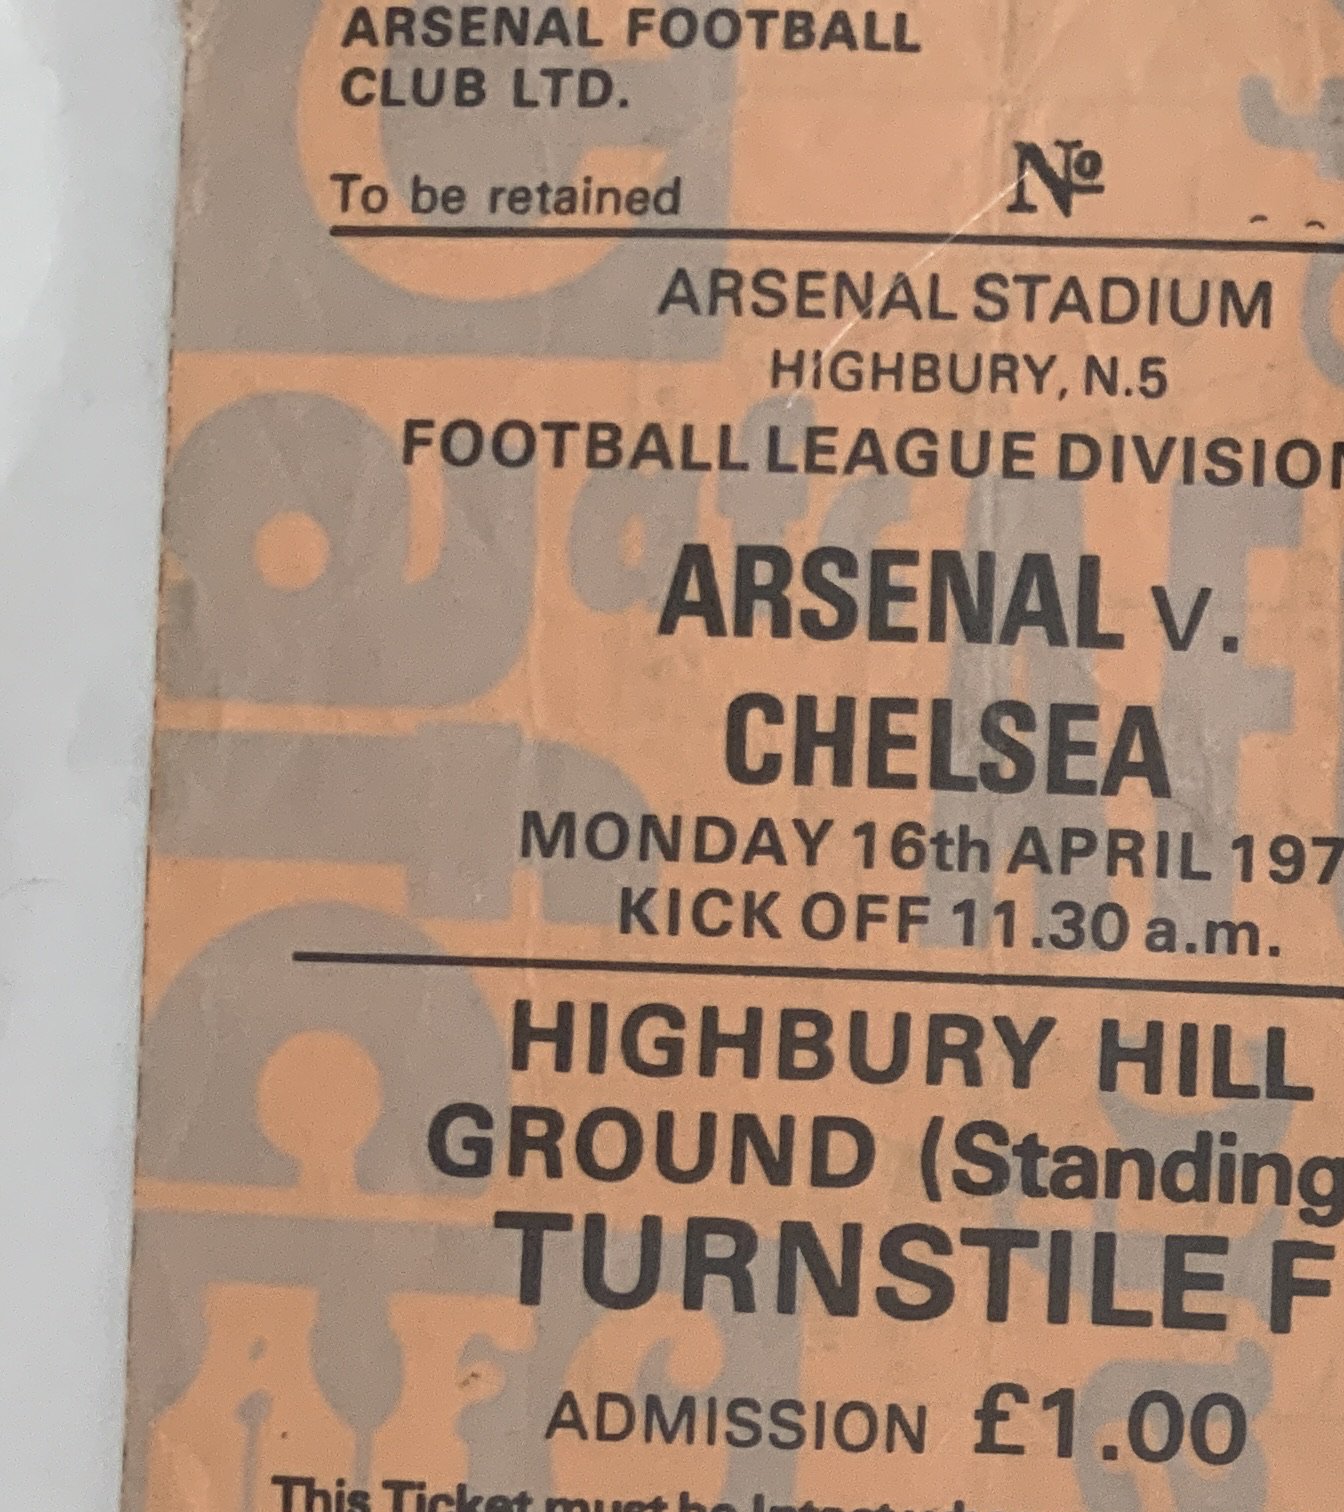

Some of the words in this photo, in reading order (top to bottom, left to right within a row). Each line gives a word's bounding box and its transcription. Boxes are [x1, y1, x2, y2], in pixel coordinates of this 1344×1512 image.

[340, 6, 603, 48] ARSENAL
[627, 7, 922, 53] FOOTBALL
[340, 66, 487, 108] CLUB
[512, 68, 629, 109] LTD.
[331, 173, 387, 215] To
[411, 175, 466, 215] be
[488, 176, 681, 217] retained
[658, 269, 957, 322] ARSENAL
[973, 273, 1273, 328] STADIUM
[770, 351, 1068, 400] HIGHBURY,
[1084, 358, 1168, 397] N.5
[402, 420, 748, 472] FOOTBALL
[767, 425, 1037, 479] LEAGUE
[658, 543, 1125, 650] ARSENAL
[724, 692, 1172, 799] CHELSEA
[520, 811, 836, 868] MONDAY
[852, 821, 992, 875] 16th
[1007, 825, 1213, 884] APRIL
[618, 887, 781, 940] KICK
[802, 892, 930, 946] OFF
[951, 899, 1129, 952] 11.30
[1145, 915, 1281, 958] a.m.
[510, 999, 1056, 1090] HIGHBURY
[1098, 1019, 1314, 1102] HILL
[427, 1102, 876, 1188] GROUND
[494, 1211, 1228, 1333] TURNSTILE
[1270, 1241, 1336, 1334] F
[544, 1391, 926, 1456] ADMISSION
[973, 1383, 1248, 1466] £1.00
